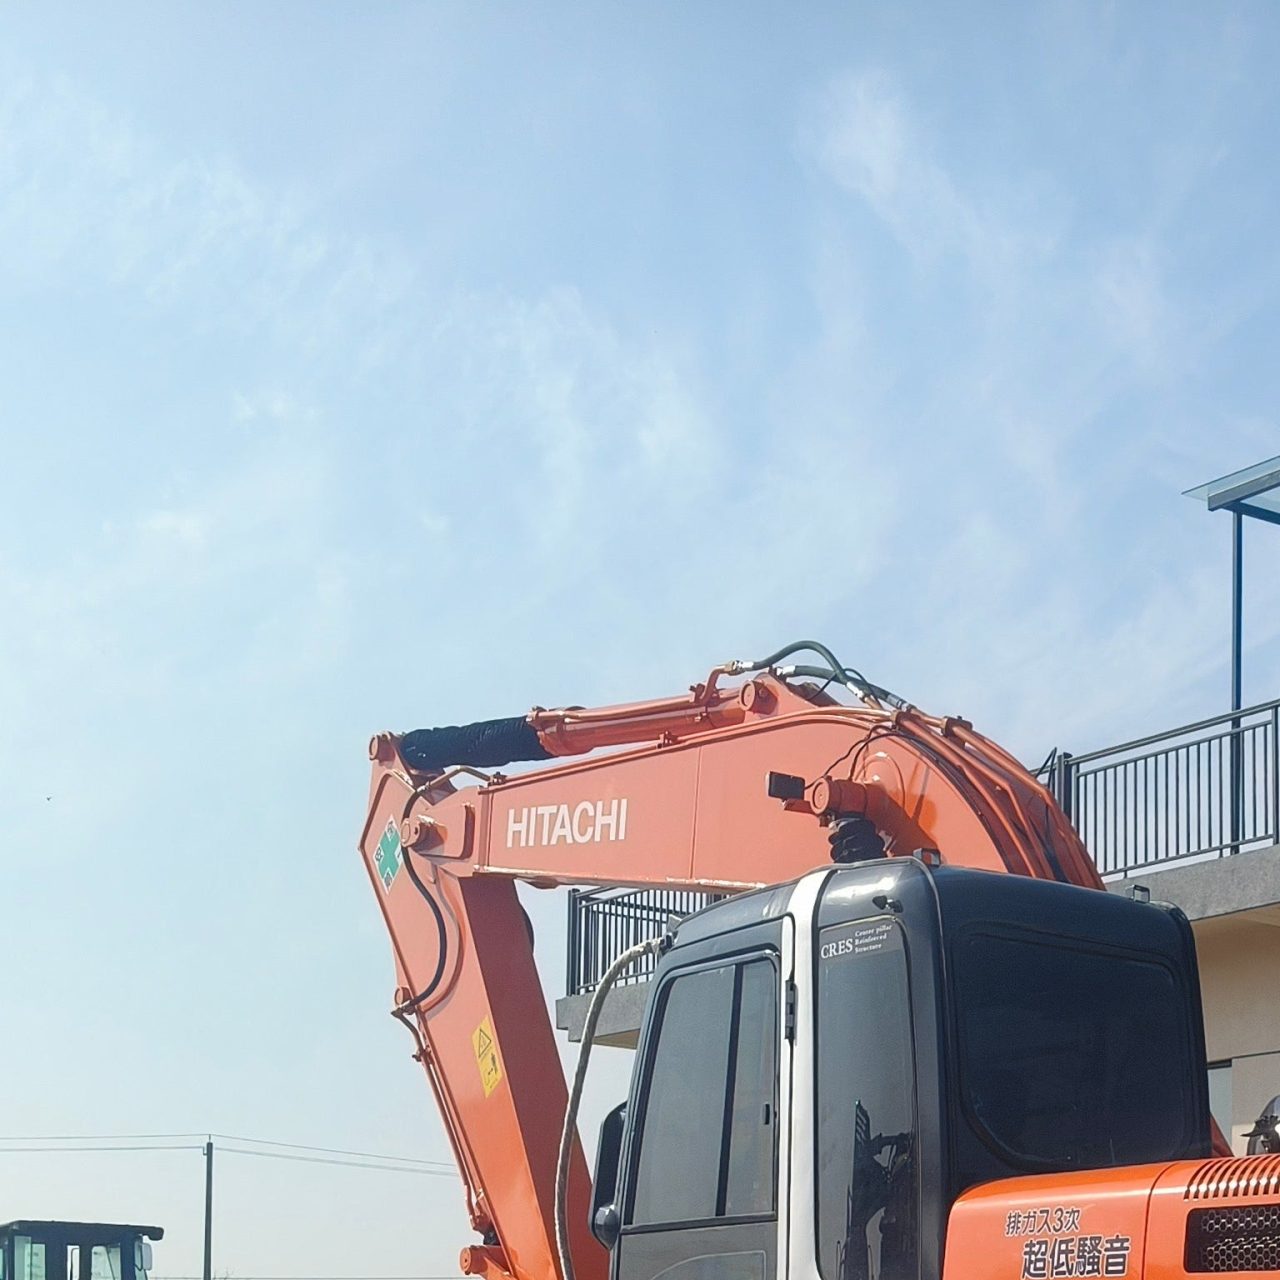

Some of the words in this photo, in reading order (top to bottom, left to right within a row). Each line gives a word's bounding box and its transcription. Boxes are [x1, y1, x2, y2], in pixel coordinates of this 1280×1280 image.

[507, 798, 627, 848] HITACHI
[820, 938, 853, 959] CRES
[1005, 1206, 1081, 1236] 排ガス3次
[1021, 1234, 1130, 1279] 超低騒音
